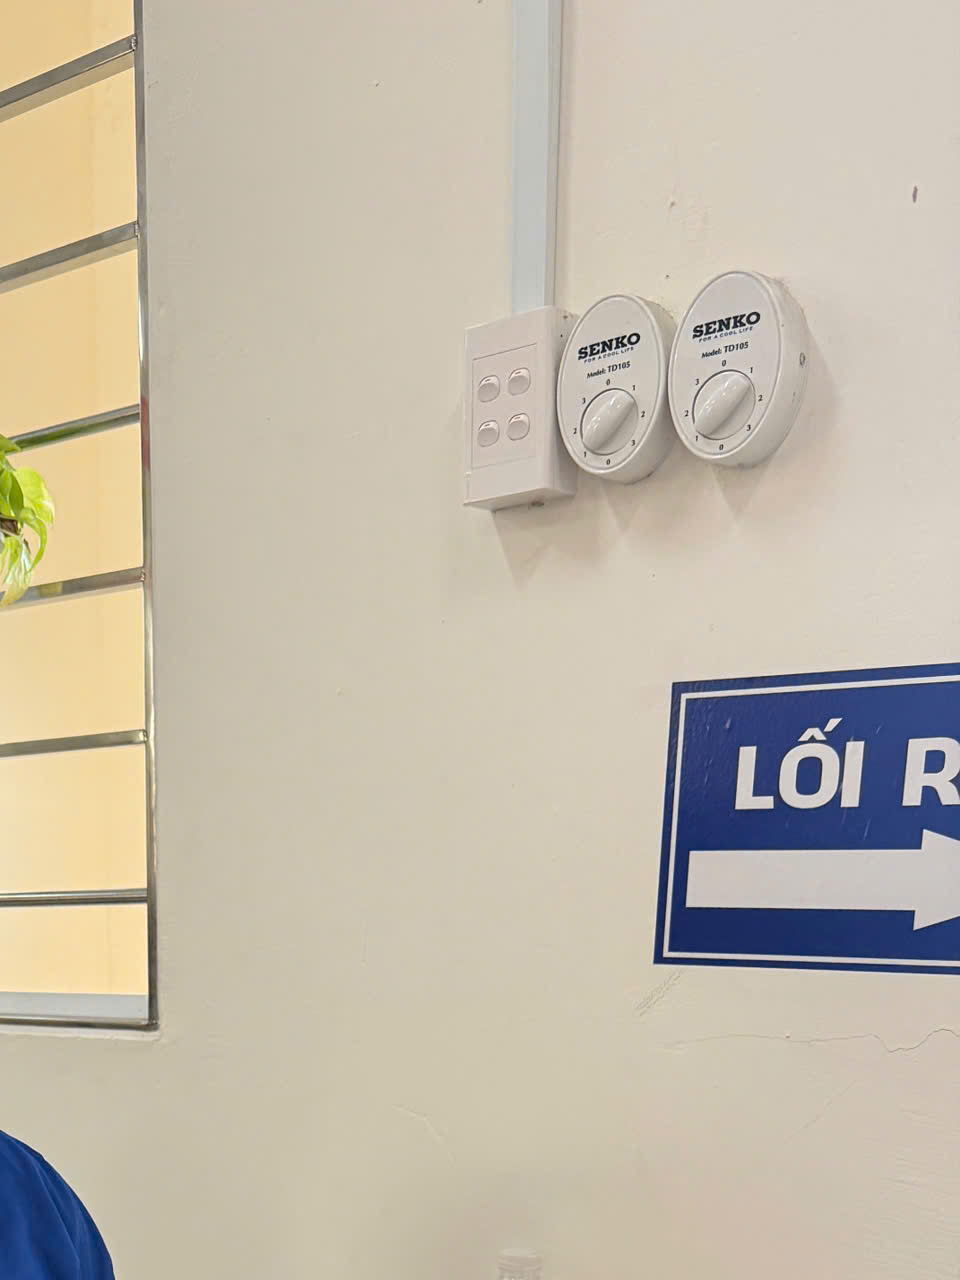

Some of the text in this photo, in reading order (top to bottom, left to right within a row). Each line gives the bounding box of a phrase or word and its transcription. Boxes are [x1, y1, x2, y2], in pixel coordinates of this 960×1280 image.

[692, 311, 761, 340] SENKO
[699, 334, 712, 343] FOR
[719, 329, 737, 338] COOL
[739, 326, 754, 334] LIFE
[577, 332, 641, 361] SENKO
[701, 341, 749, 359] Model: TD105
[603, 351, 620, 359] COOL
[620, 346, 635, 355] LIFE
[721, 359, 727, 367] 0
[586, 360, 631, 380] Model: TD105
[749, 366, 754, 374] 1
[605, 378, 611, 386] 0
[695, 378, 700, 386] 3
[632, 384, 636, 392] 1
[758, 394, 763, 402] 2
[640, 410, 646, 418] 2
[684, 409, 690, 417] 2
[746, 424, 752, 432] 3
[631, 439, 636, 447] 3
[718, 443, 724, 451] 0
[606, 458, 611, 466] 0
[734, 717, 960, 811] LỐI R
